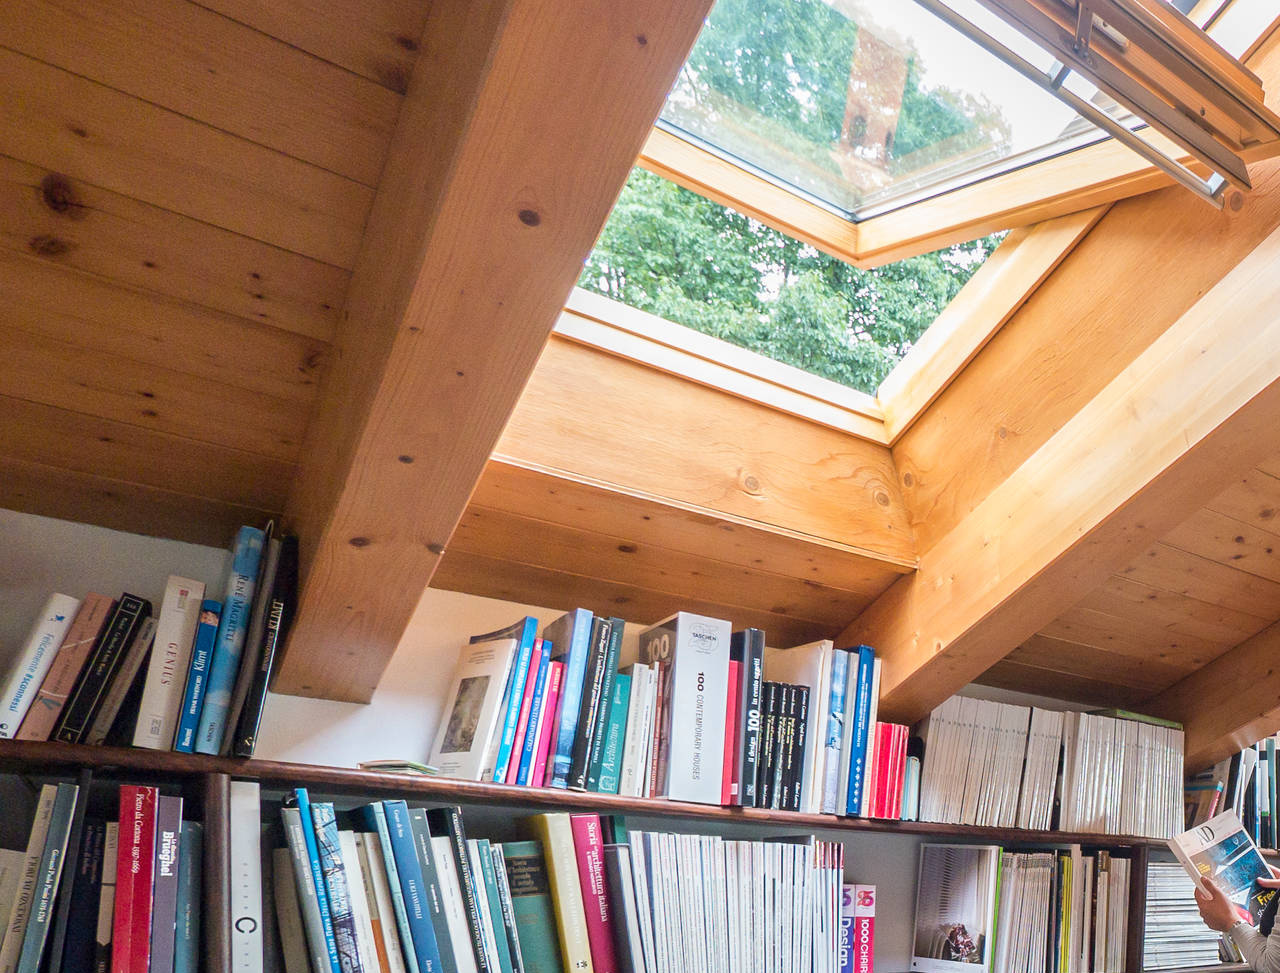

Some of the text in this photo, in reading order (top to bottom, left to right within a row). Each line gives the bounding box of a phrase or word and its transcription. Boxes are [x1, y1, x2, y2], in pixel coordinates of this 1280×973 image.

[27, 632, 54, 675] Felicemente
[160, 641, 178, 685] GENIUS
[194, 648, 208, 671] Klimt
[751, 657, 761, 680] oggetti
[750, 679, 760, 698] cento
[531, 695, 541, 715] LUNARE
[750, 697, 759, 705] in
[691, 671, 705, 779] 100 CONTEMPORARY HOUSES
[747, 708, 760, 732] 100
[525, 714, 538, 752] CALENDARIO
[602, 721, 620, 771] Architettura
[747, 736, 757, 756] design
[134, 793, 145, 811] Pietro
[133, 811, 143, 820] da
[131, 820, 142, 845] Cortona
[1197, 826, 1215, 846] AD
[157, 830, 174, 878] Brueghel
[310, 859, 324, 896] REPUBBLICA
[585, 821, 598, 846] Storia
[596, 894, 609, 922] italiana
[318, 896, 329, 917] DELLA
[1257, 890, 1276, 906] Free
[839, 916, 851, 966] Design
[859, 918, 869, 943] 1000
[327, 937, 337, 954] SEDE
[331, 955, 340, 964] LA
